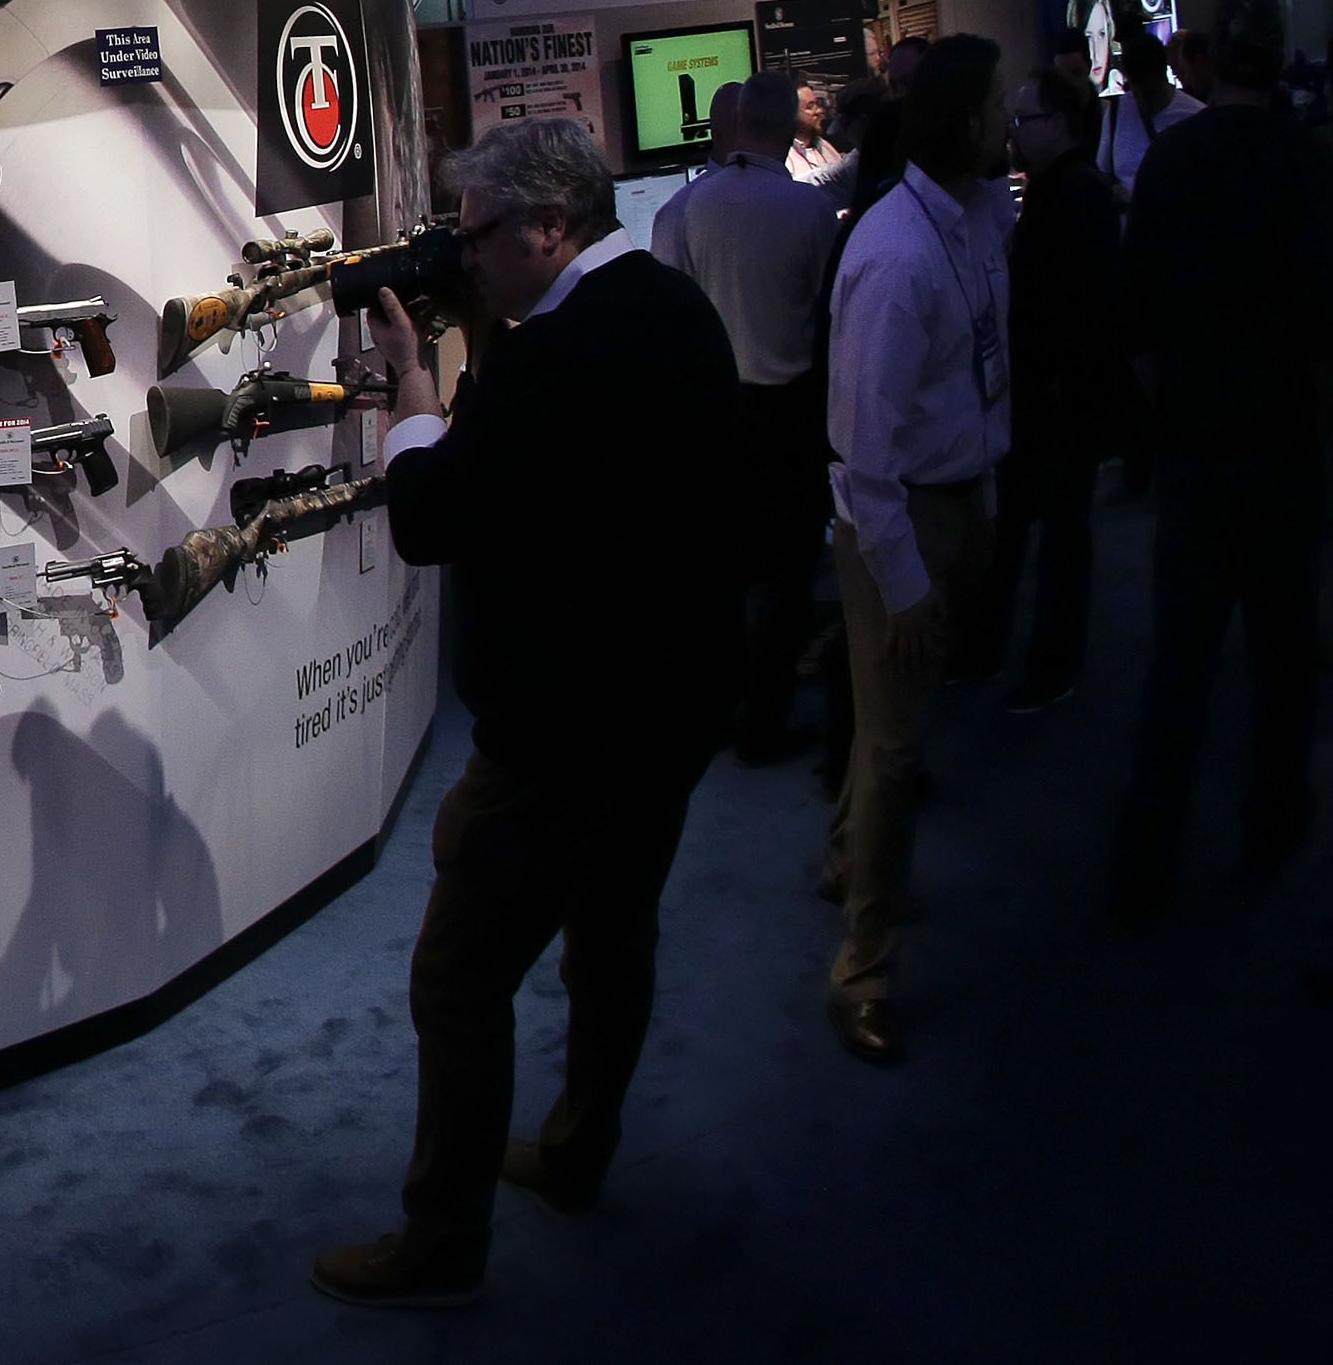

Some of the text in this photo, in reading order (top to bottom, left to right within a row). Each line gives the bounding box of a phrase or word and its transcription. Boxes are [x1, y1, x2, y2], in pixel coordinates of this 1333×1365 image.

[106, 34, 130, 46] This
[470, 32, 592, 66] NATION'S FINEST
[100, 49, 158, 63] Under Video
[101, 65, 160, 80] Surveillance
[296, 652, 341, 700] When
[346, 624, 389, 678] you're
[295, 698, 331, 749] tired
[336, 686, 358, 723] it's
